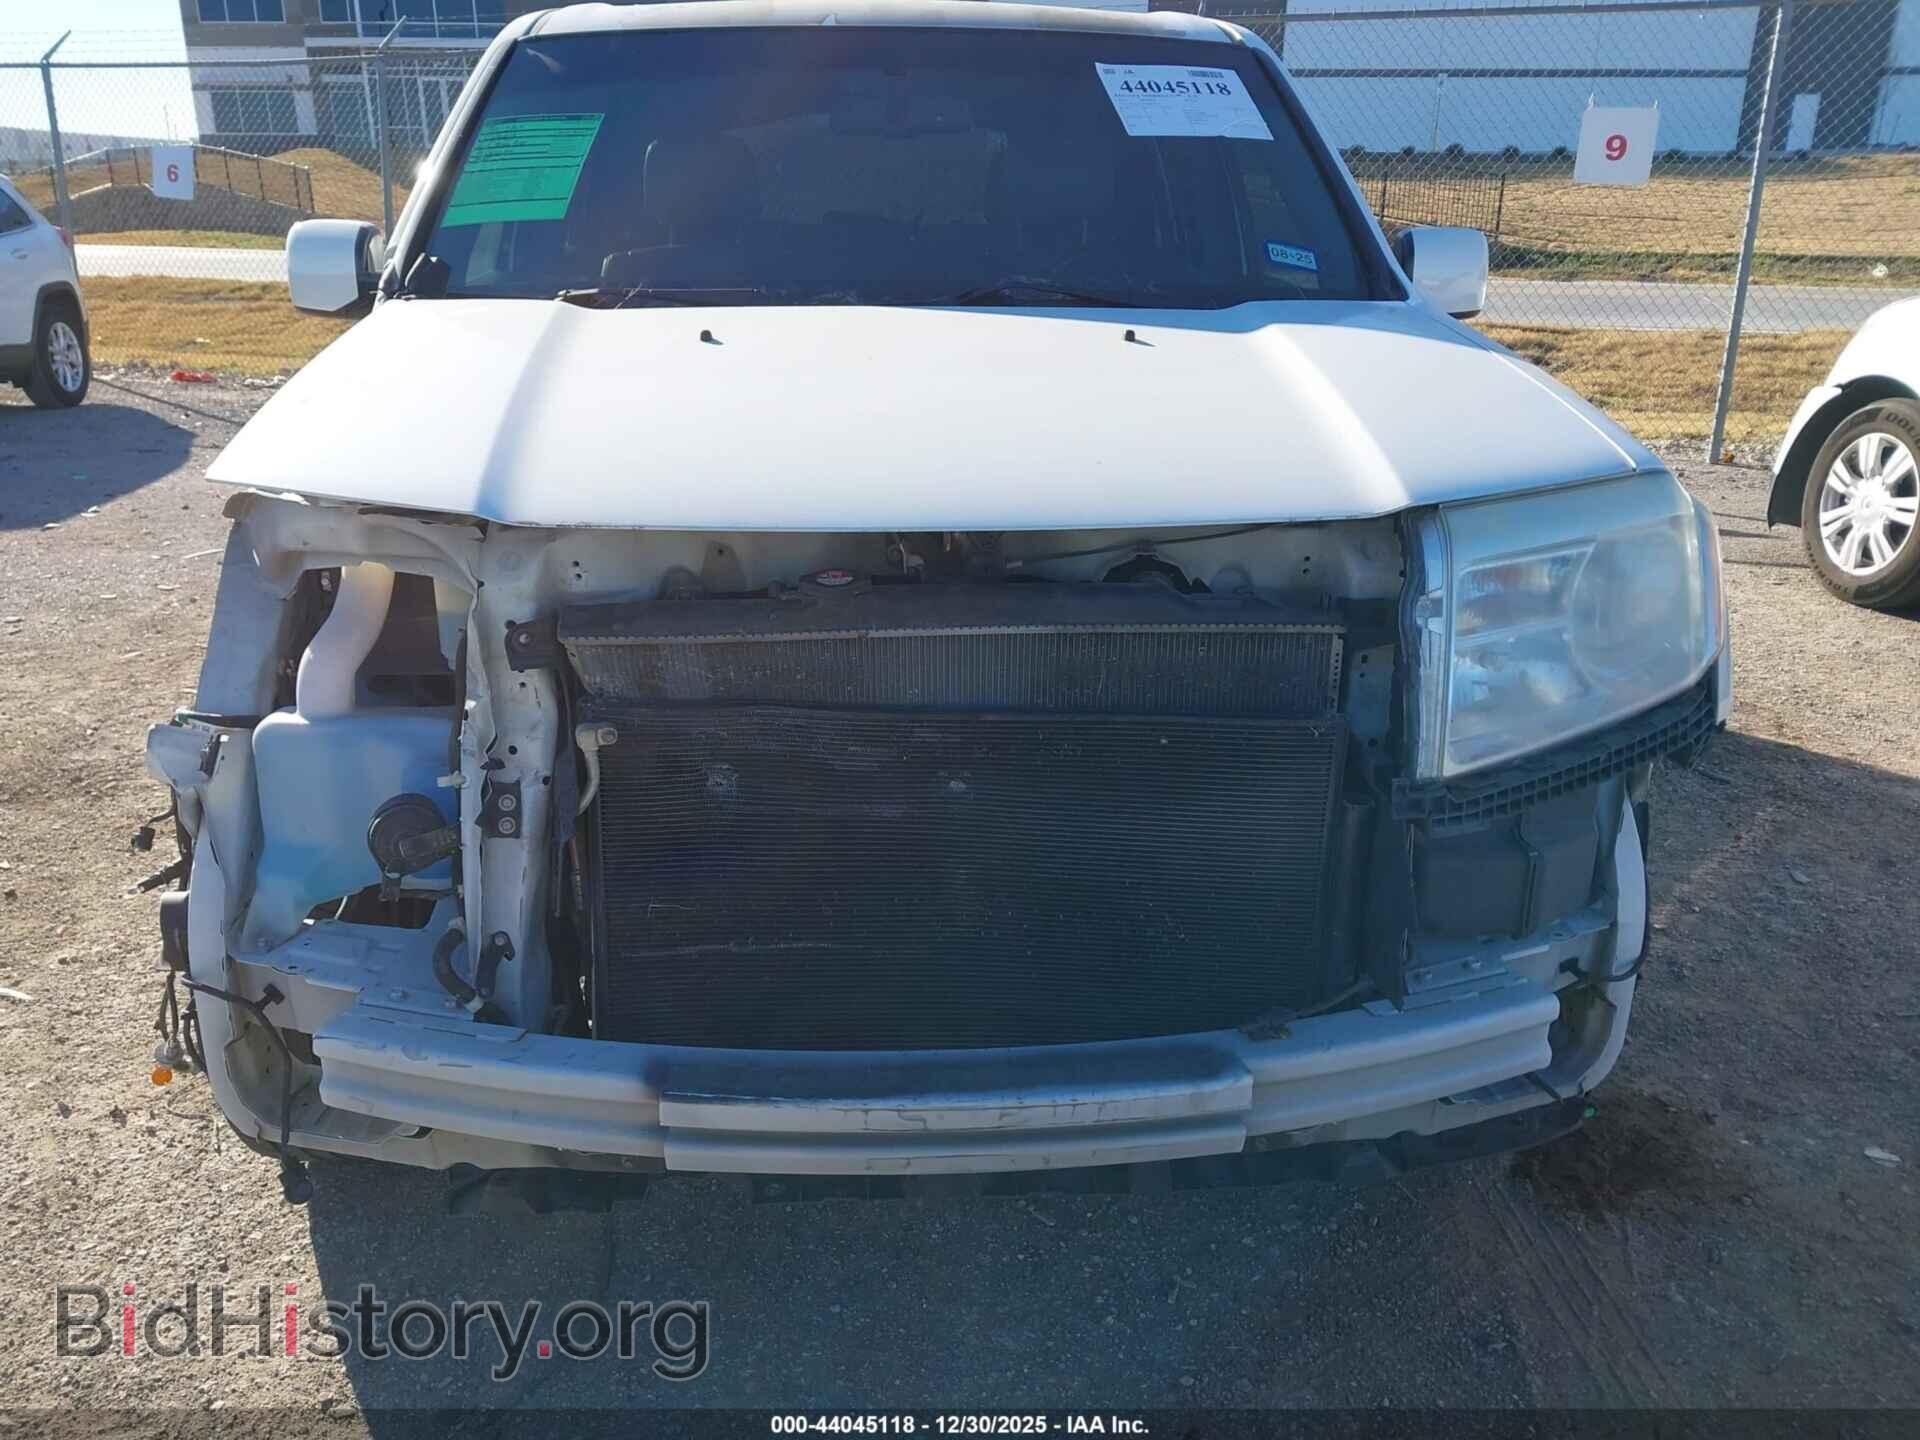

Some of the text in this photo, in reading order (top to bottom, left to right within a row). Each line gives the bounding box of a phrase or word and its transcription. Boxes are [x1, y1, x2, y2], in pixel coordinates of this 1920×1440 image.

[1120, 79, 1231, 96] 44045118
[1605, 134, 1627, 160] 9
[167, 164, 178, 182] 6
[1271, 247, 1313, 265] 08-25
